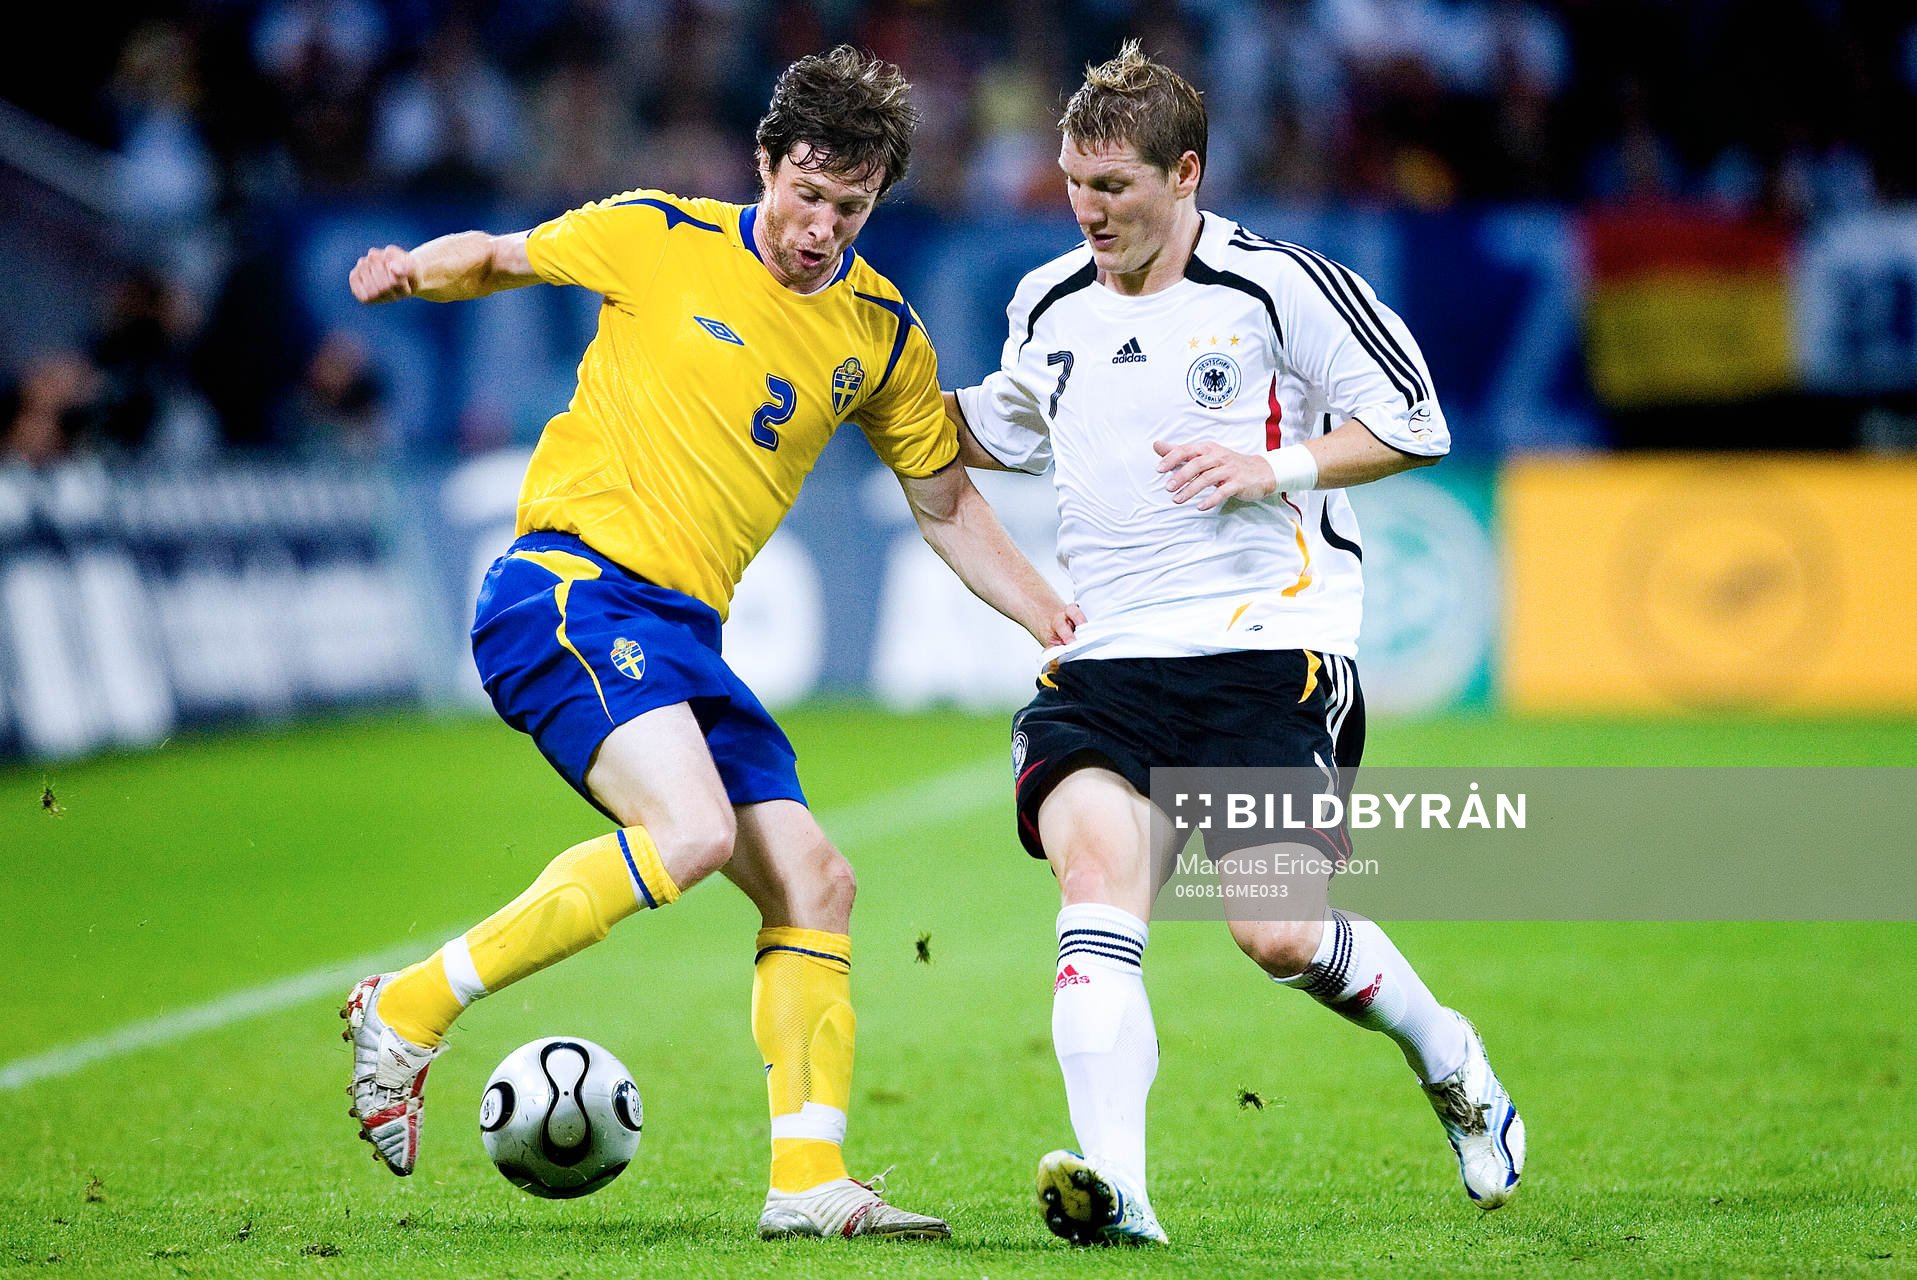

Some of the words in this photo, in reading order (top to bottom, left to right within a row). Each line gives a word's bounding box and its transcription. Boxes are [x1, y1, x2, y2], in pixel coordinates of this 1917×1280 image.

[1047, 350, 1075, 420] 7
[1112, 354, 1147, 364] adidas
[751, 373, 797, 451] 2
